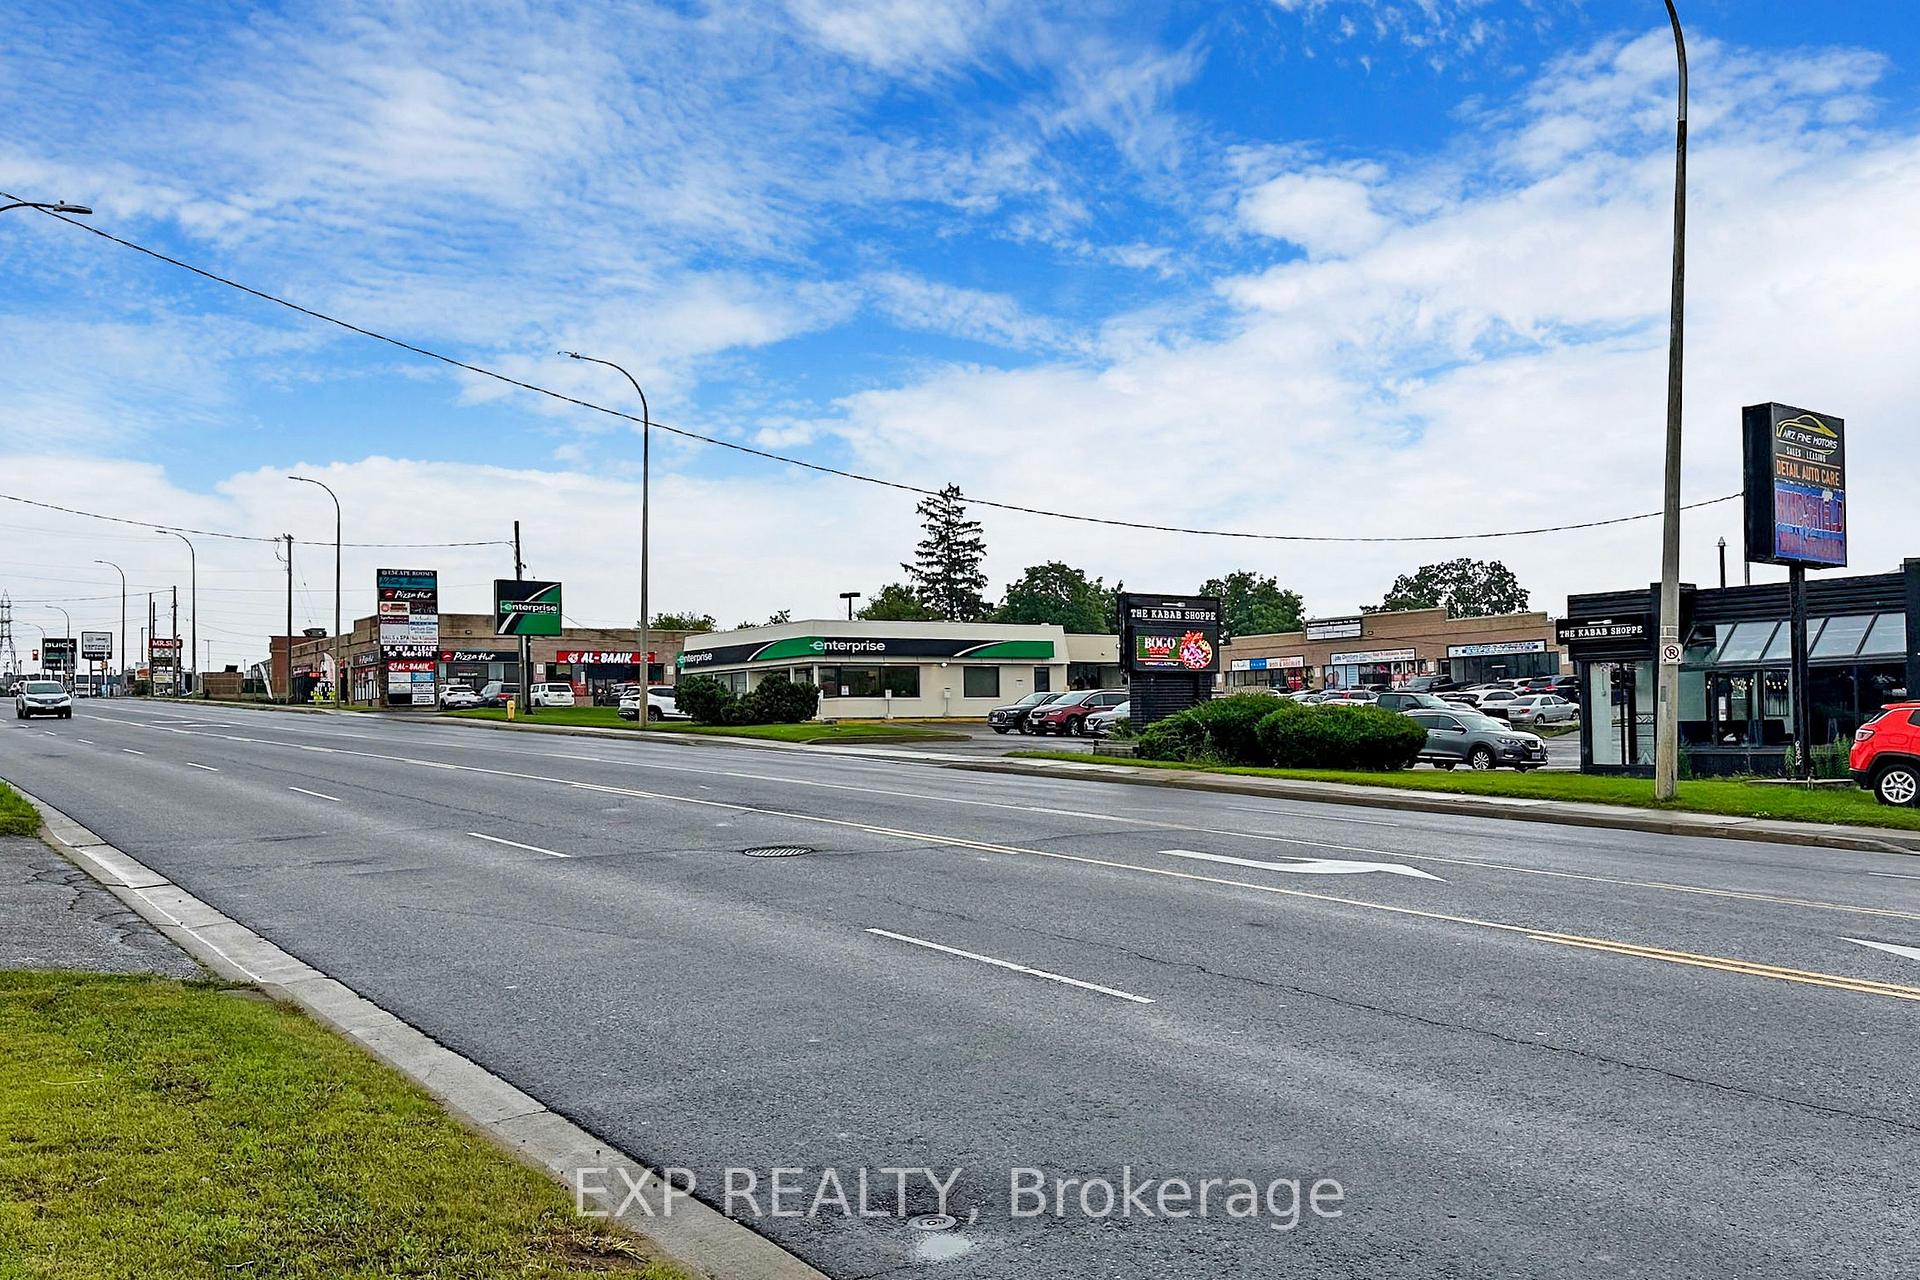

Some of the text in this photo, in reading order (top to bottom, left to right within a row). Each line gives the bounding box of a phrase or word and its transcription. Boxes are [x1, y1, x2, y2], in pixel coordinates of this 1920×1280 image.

[1797, 433, 1812, 444] FINE
[1813, 436, 1838, 450] MOTORS
[1786, 446, 1826, 463] SALES LEASING
[1776, 460, 1840, 487] DETAIL AUTO CARE
[394, 590, 432, 599] Pizza Hut
[502, 603, 557, 612] enterprise
[1130, 608, 1216, 620] THE KABAB SHOPPE
[1559, 626, 1643, 638] THE KABAB SHOPPE
[809, 640, 886, 654] enterprise
[1144, 637, 1176, 649] BOGO
[454, 651, 496, 661] Pizza Hut
[580, 652, 633, 664] AL-BAAIK
[677, 651, 713, 664] enterprise
